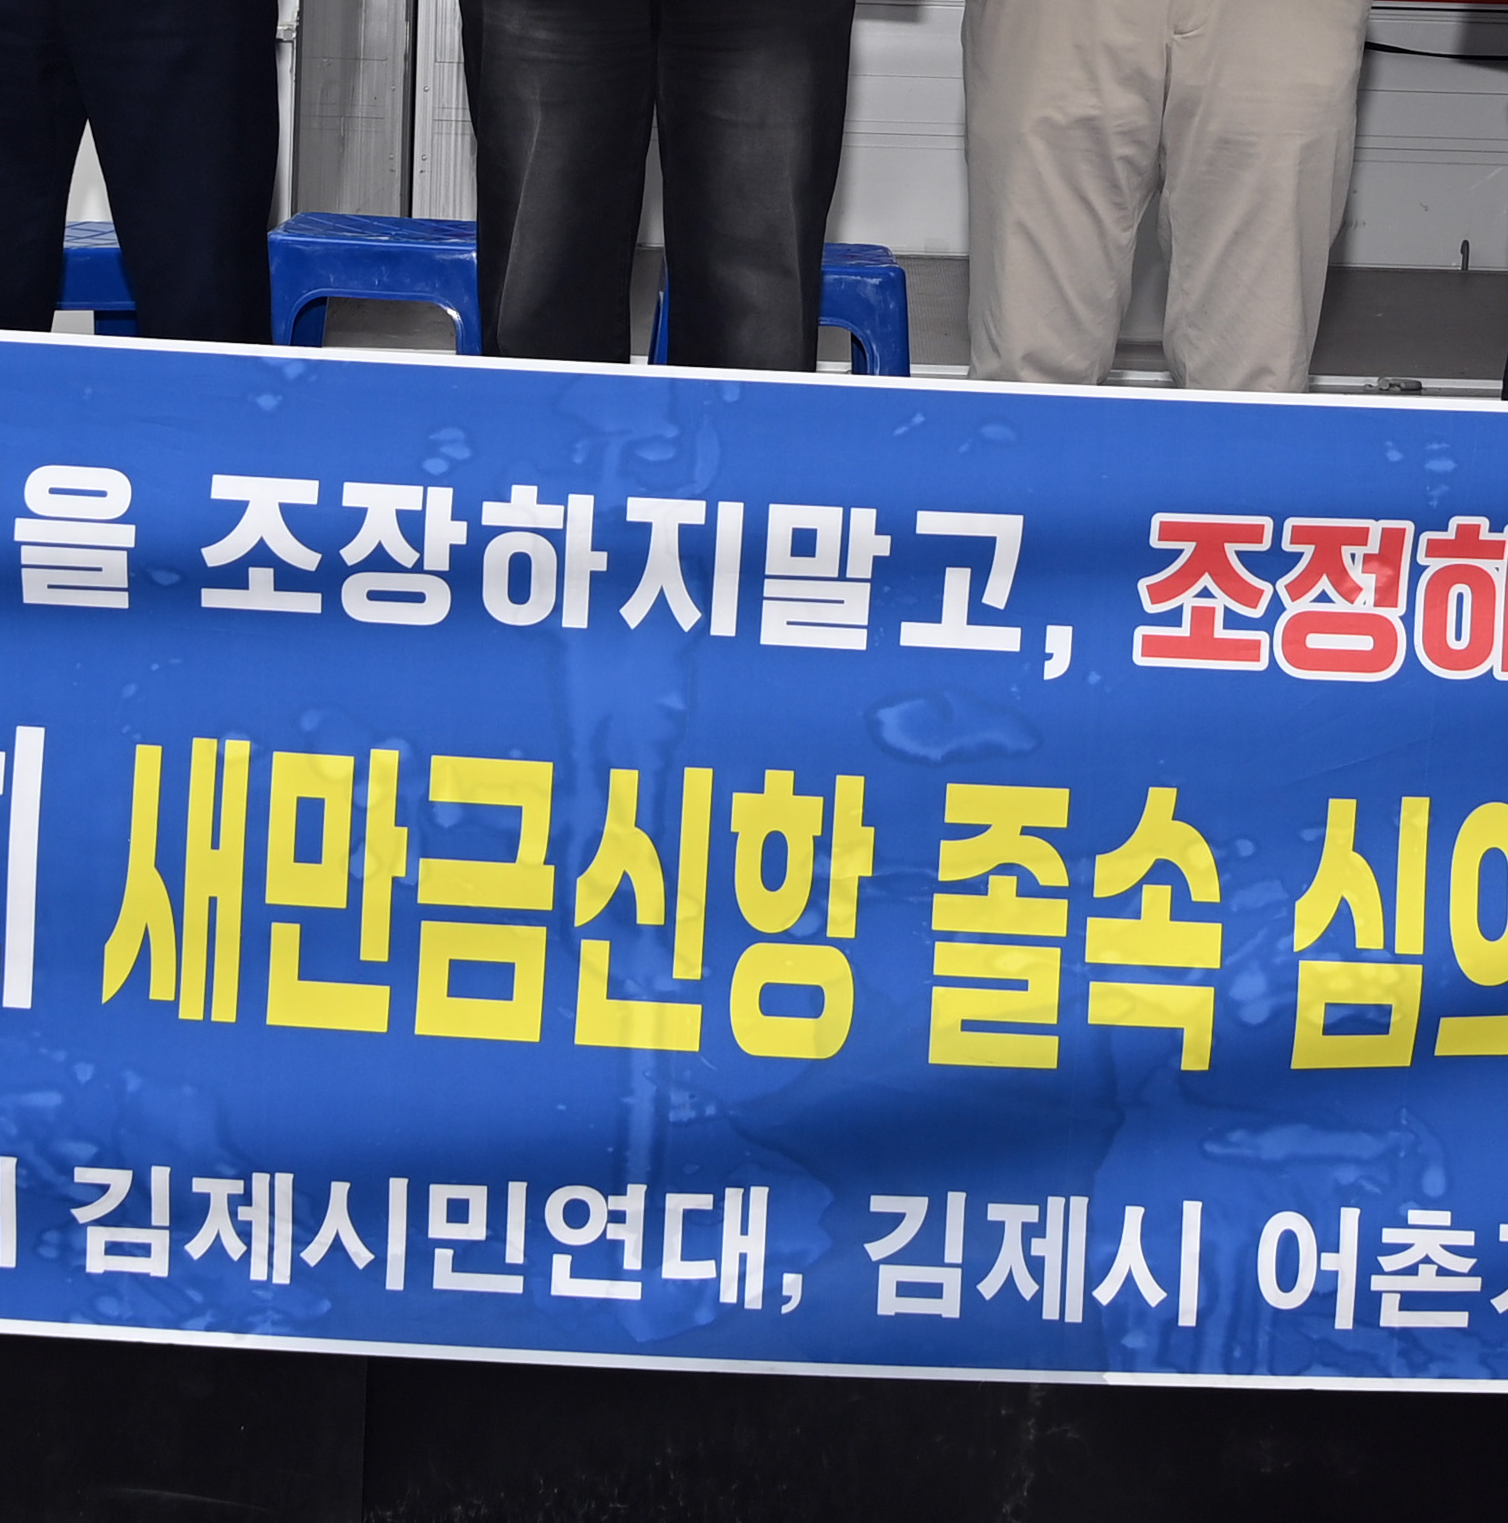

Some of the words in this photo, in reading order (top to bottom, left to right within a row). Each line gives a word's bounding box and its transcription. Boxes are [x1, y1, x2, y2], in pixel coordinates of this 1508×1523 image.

[200, 473, 1072, 680] 조장하지말고,
[102, 734, 876, 1060] 새만금신항
[927, 782, 1222, 1072] 졸속
[69, 1164, 804, 1315] 김제시민연대,
[863, 1190, 1202, 1328] 김제시
